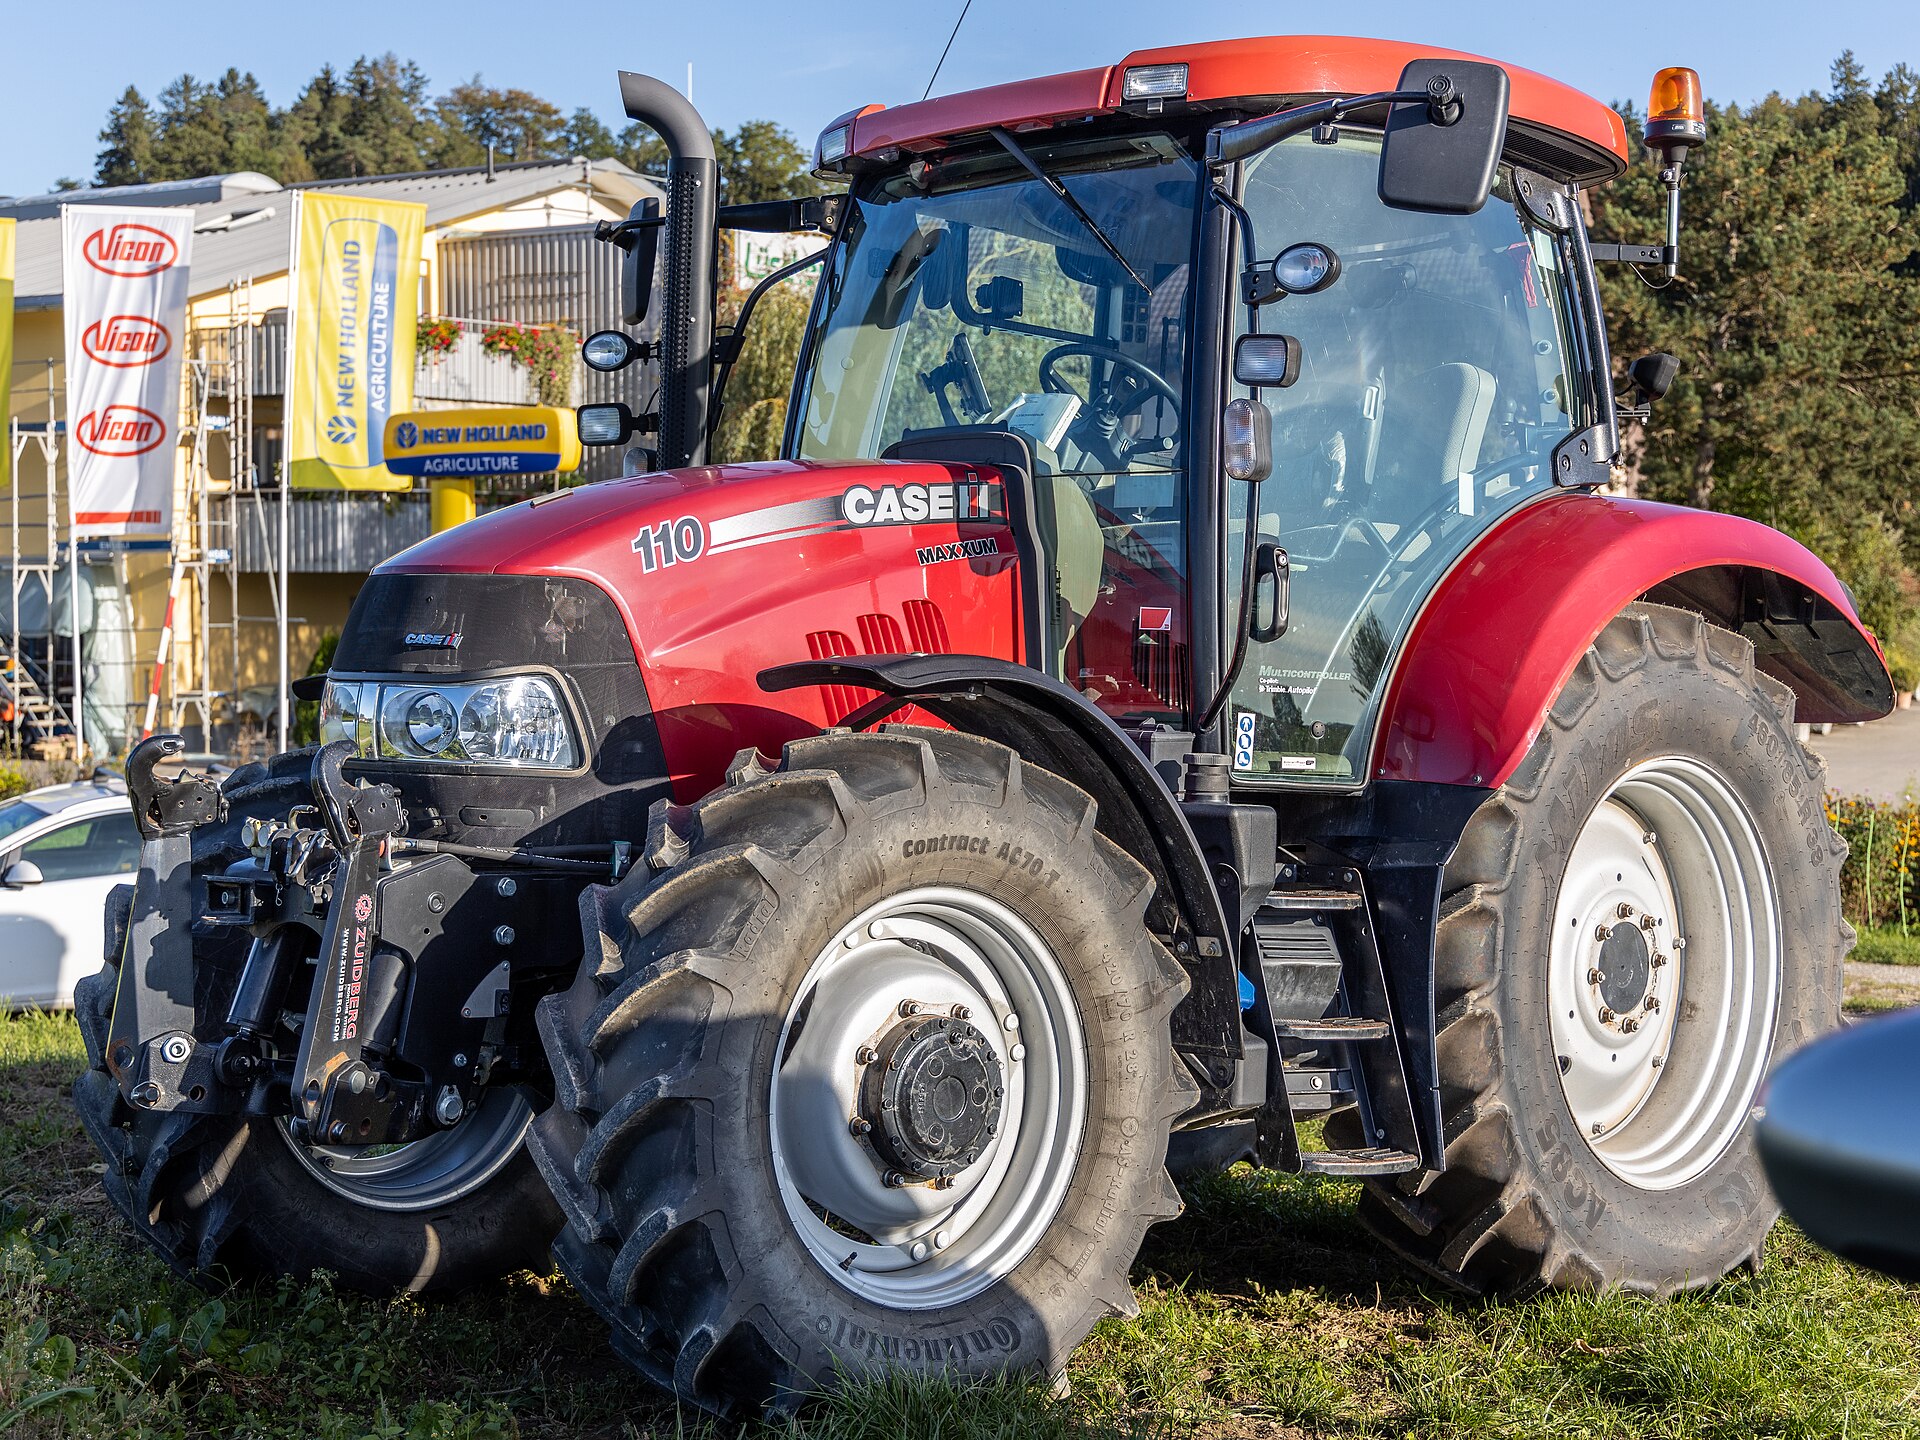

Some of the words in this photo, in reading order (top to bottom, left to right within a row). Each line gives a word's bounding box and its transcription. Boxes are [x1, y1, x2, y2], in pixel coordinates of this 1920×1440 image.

[97, 227, 166, 262] Vicon
[339, 240, 361, 349] HOLLAND
[95, 319, 159, 353] Vicon
[371, 281, 390, 414] AGRICULTURE
[337, 354, 356, 408] NEW
[89, 410, 154, 442] Vicon
[421, 427, 462, 444] NEW
[465, 424, 548, 442] HOLLAND
[423, 456, 520, 473] AGRICULTURE
[842, 483, 954, 526] CASE
[630, 515, 705, 574] 110
[915, 537, 999, 566] MAXXUM
[404, 633, 445, 646] CASE
[1258, 665, 1352, 681] MULTICONTROLLER
[995, 842, 1044, 877] AC70
[1044, 869, 1061, 890] T
[332, 928, 350, 1042] WWW.ZUIDBERG.COM
[347, 926, 367, 1040] ZUIDBERG
[1535, 1112, 1607, 1232] AC85
